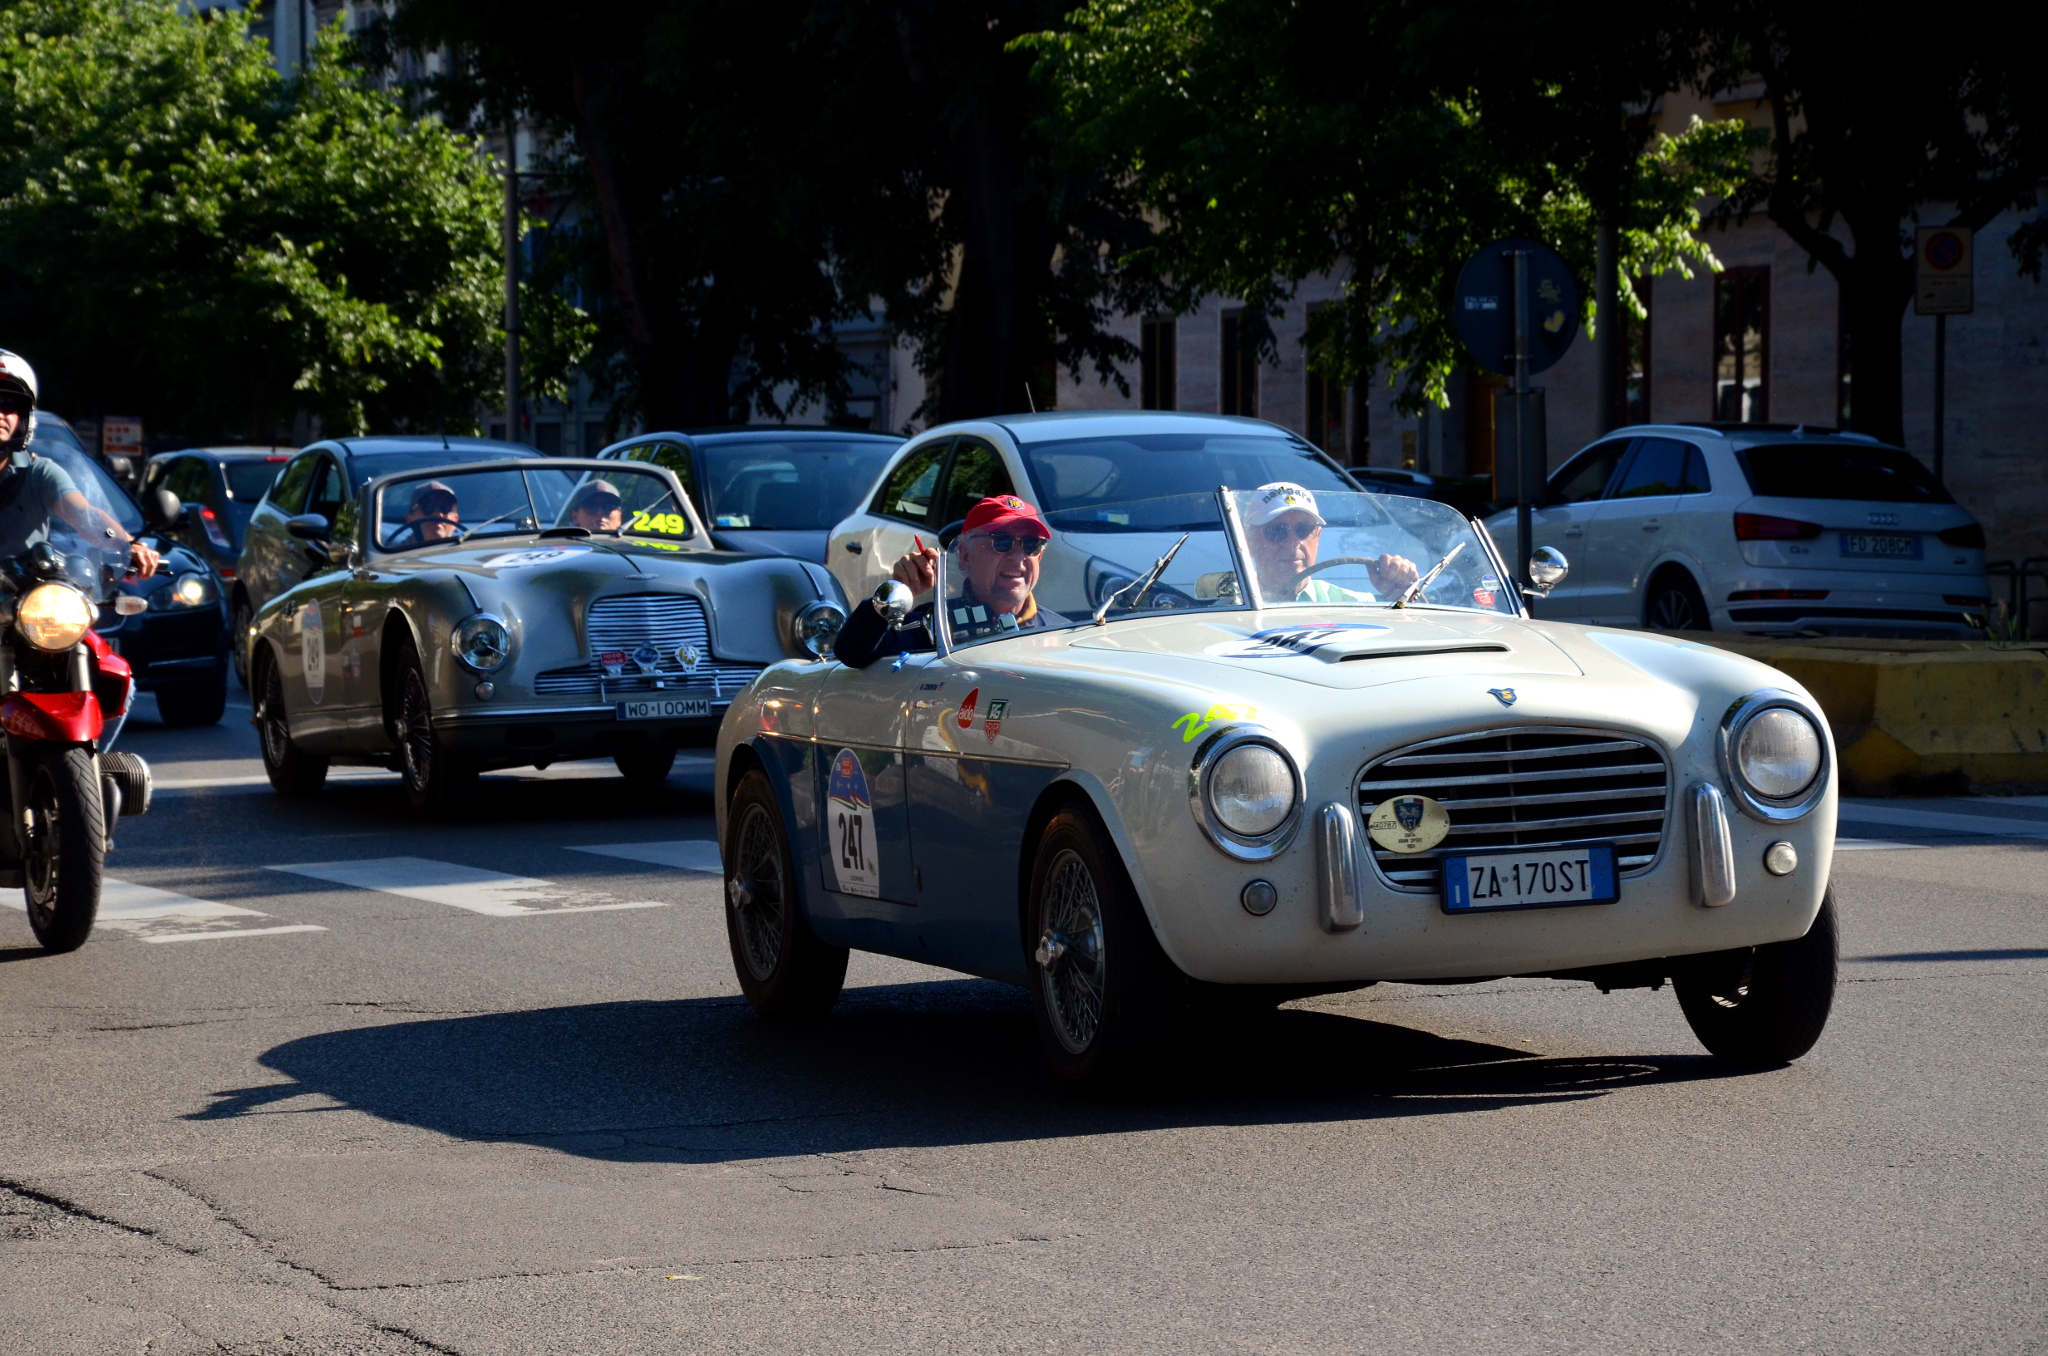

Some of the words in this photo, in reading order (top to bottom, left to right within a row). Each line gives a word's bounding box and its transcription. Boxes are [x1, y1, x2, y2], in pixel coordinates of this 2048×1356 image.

[632, 510, 684, 534] 249
[1850, 537, 1867, 551] FD
[1243, 629, 1348, 651] 247
[958, 705, 974, 721] aido
[989, 703, 1002, 720] TAG
[1171, 703, 1259, 742] 247
[1375, 821, 1396, 830] 40787
[839, 812, 864, 871] 247
[1471, 867, 1502, 899] ZA
[1513, 859, 1589, 896] 170ST
